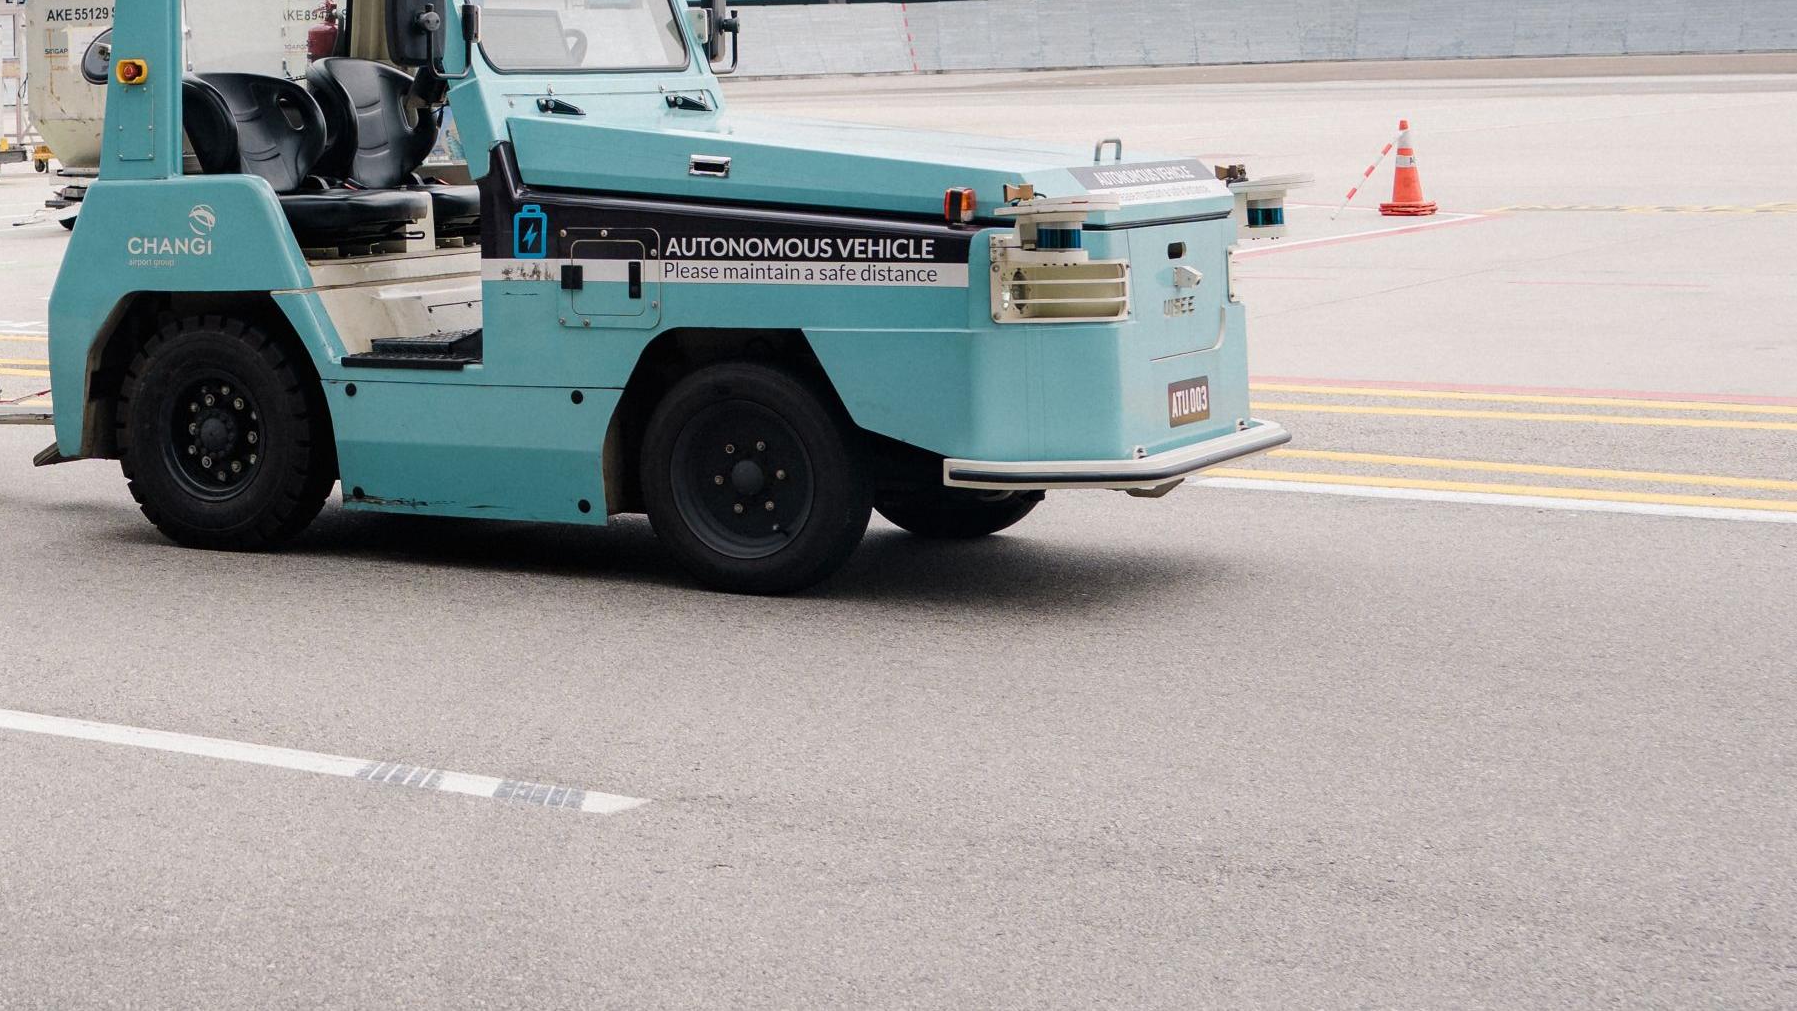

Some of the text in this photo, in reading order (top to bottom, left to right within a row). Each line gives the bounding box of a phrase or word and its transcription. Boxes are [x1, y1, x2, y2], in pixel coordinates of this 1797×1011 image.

[46, 9, 73, 22] AKE
[74, 7, 109, 21] 55129
[1093, 165, 1196, 187] AUTONOMOUS VEHICLE
[127, 236, 212, 256] CHANGI
[665, 237, 935, 259] AUTONOMOUS VEHICLE
[129, 258, 175, 268] airport group
[664, 262, 938, 283] Please maintain a safe distance
[1172, 385, 1208, 418] ATU 003
